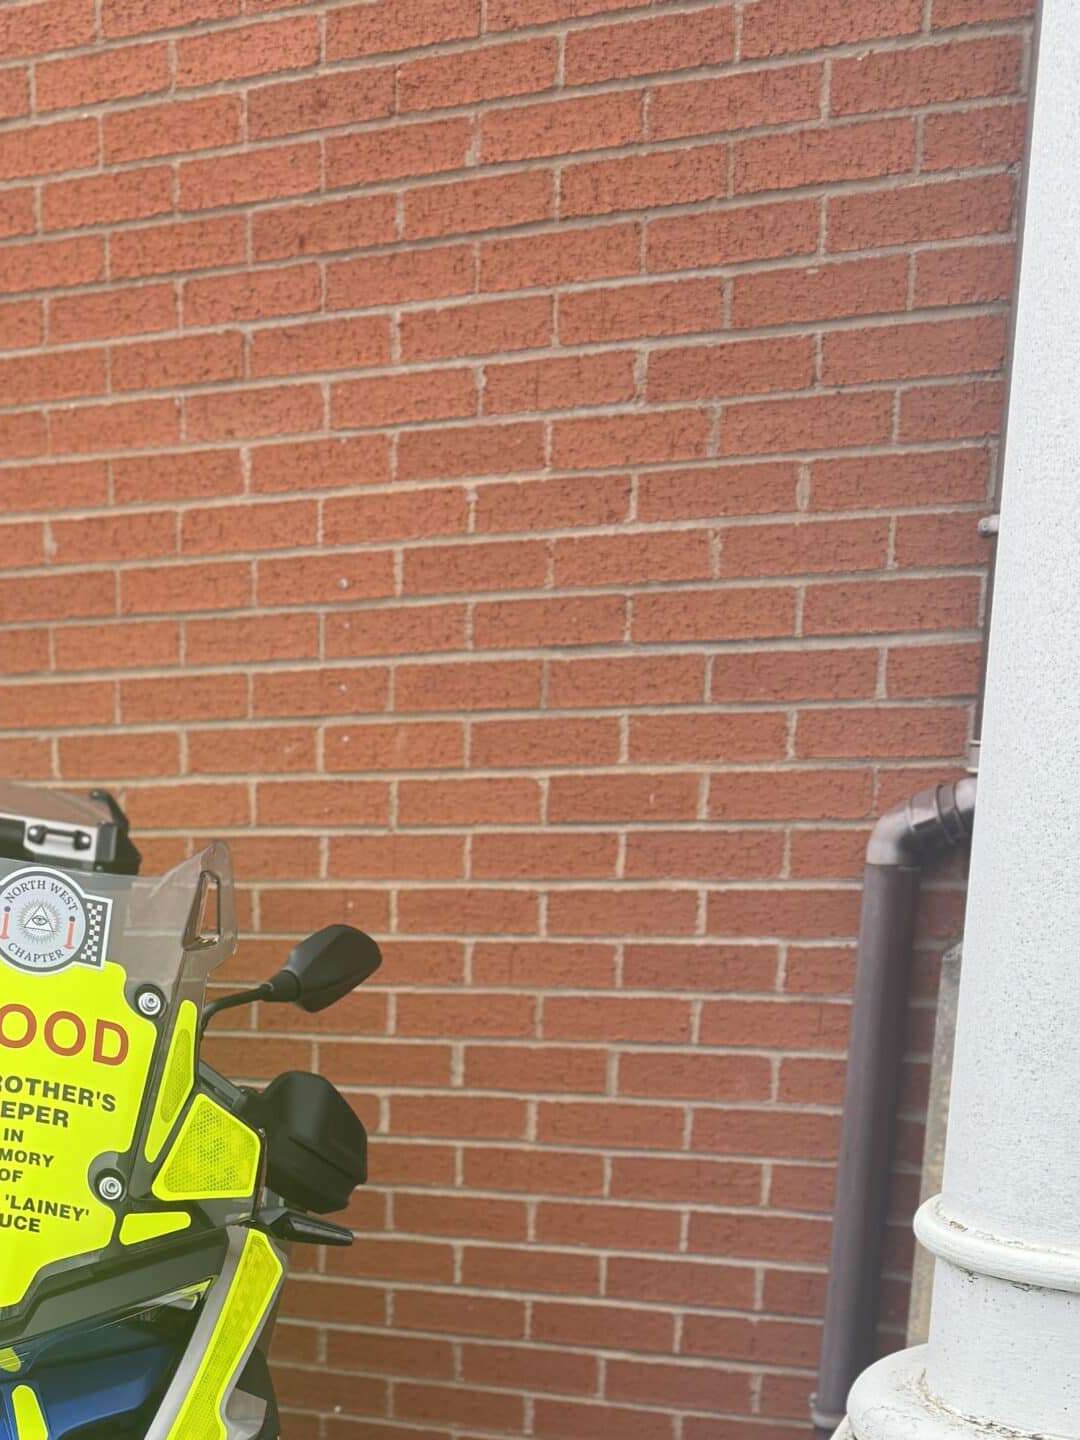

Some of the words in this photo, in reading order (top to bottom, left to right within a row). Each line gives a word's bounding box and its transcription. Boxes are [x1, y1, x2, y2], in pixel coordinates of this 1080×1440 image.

[4, 879, 46, 904] NORTH
[50, 882, 79, 912] WEST
[8, 942, 65, 963] CHAPTER
[3, 1128, 24, 1143] IN
[5, 1194, 90, 1223] 'LAINEY'
